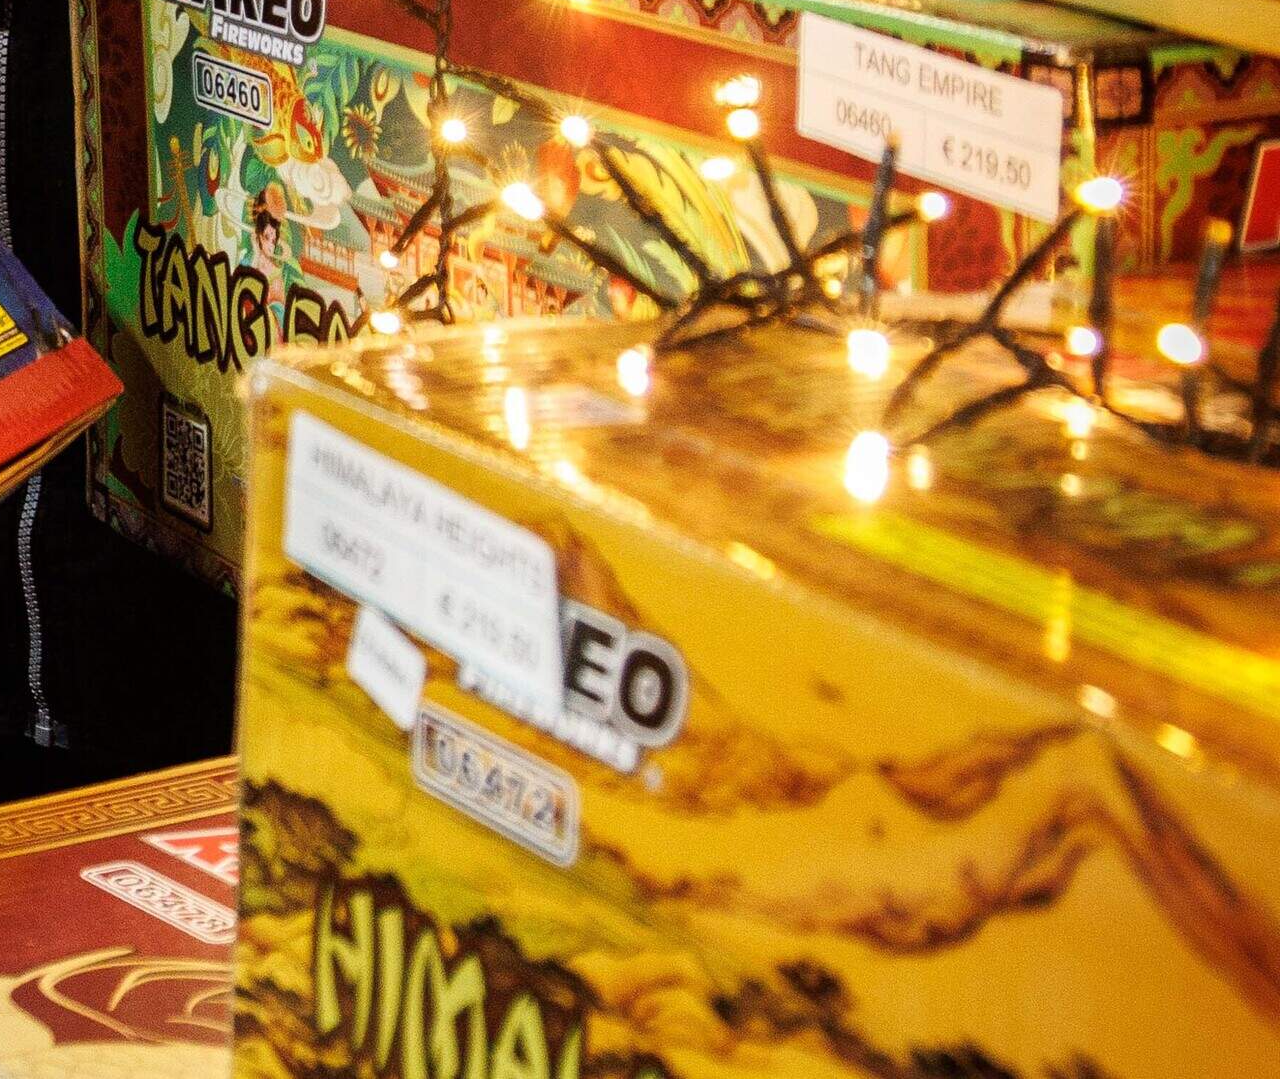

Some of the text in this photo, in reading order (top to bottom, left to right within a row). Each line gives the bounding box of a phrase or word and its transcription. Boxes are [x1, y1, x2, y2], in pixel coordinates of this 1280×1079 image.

[211, 13, 306, 66] FIREWORKS
[203, 64, 262, 113] 06460
[854, 42, 1004, 115] TANG EMPIRE
[134, 218, 272, 373] TANG
